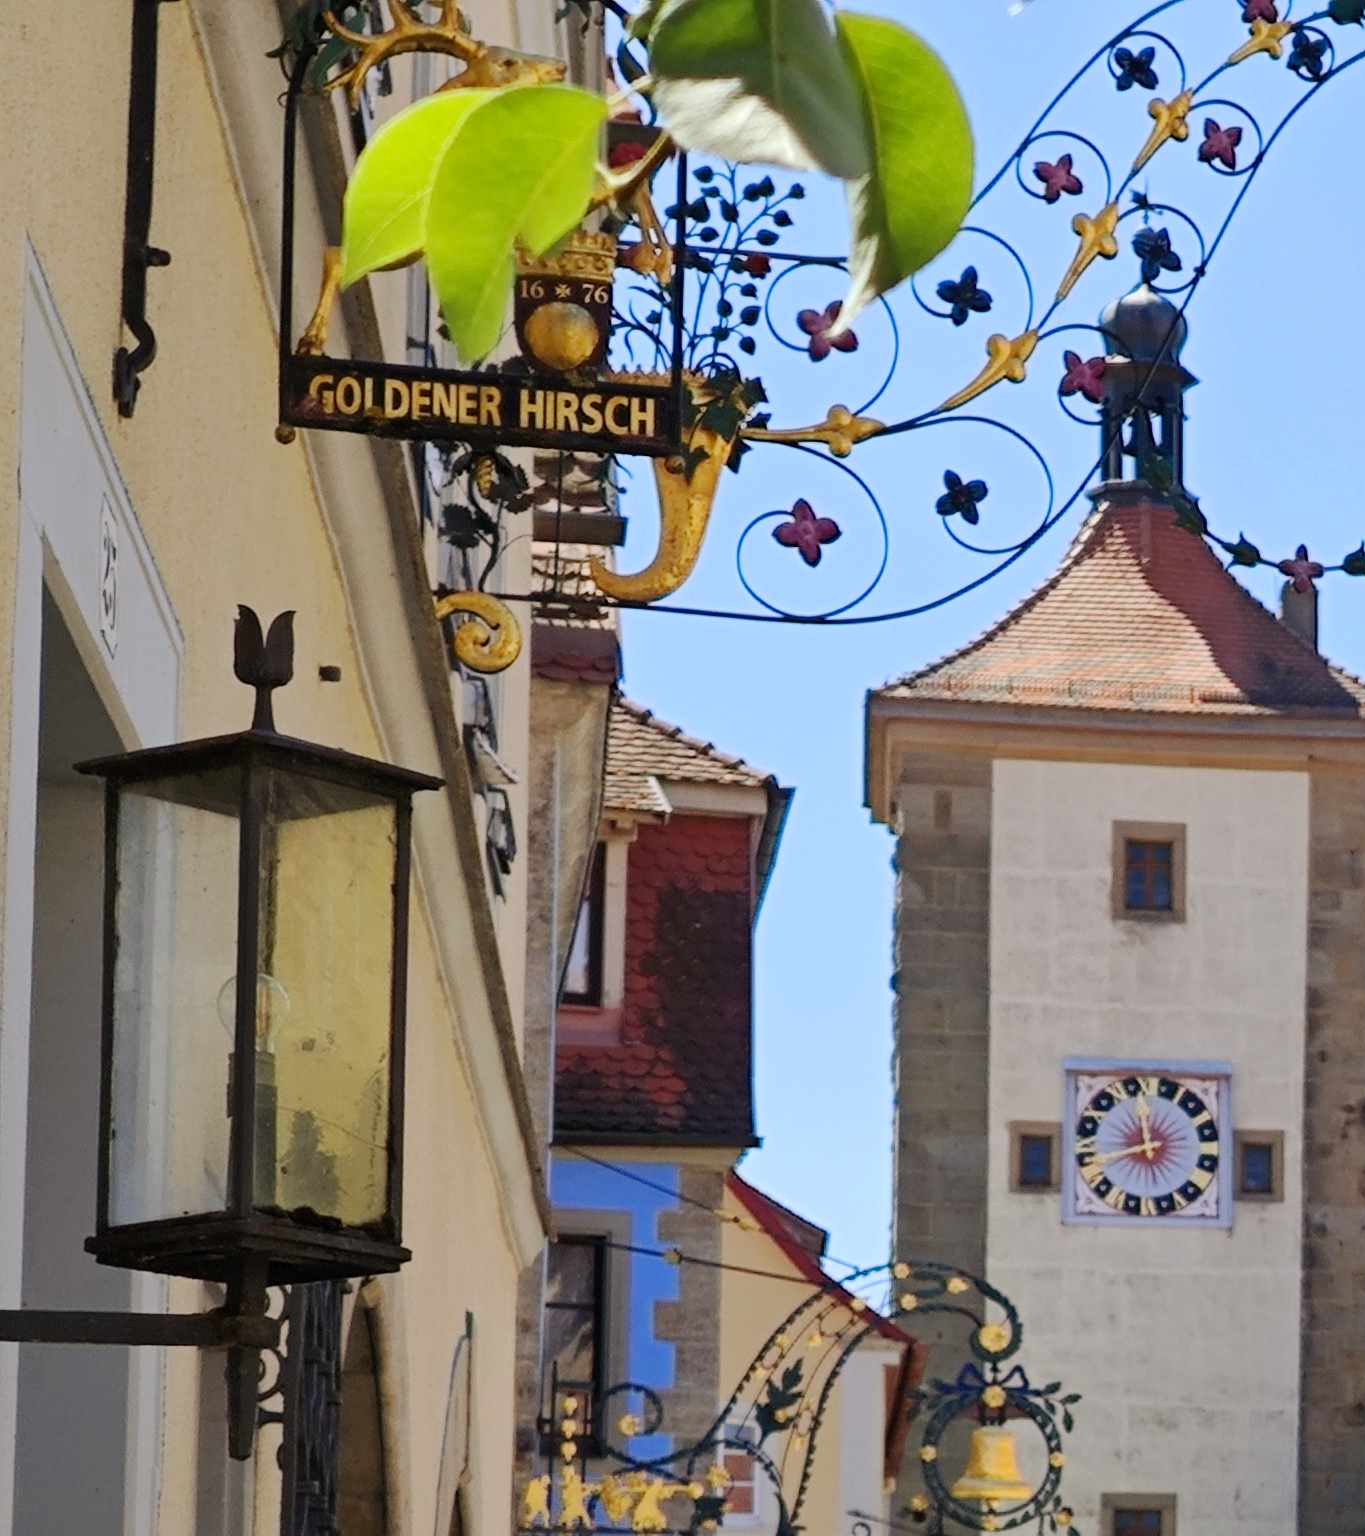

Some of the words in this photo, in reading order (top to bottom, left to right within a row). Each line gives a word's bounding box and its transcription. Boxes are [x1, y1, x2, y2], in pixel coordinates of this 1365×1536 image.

[520, 279, 544, 299] 16
[582, 284, 608, 305] 76
[309, 374, 501, 427] GOLDENER
[519, 388, 656, 438] HIRSCH
